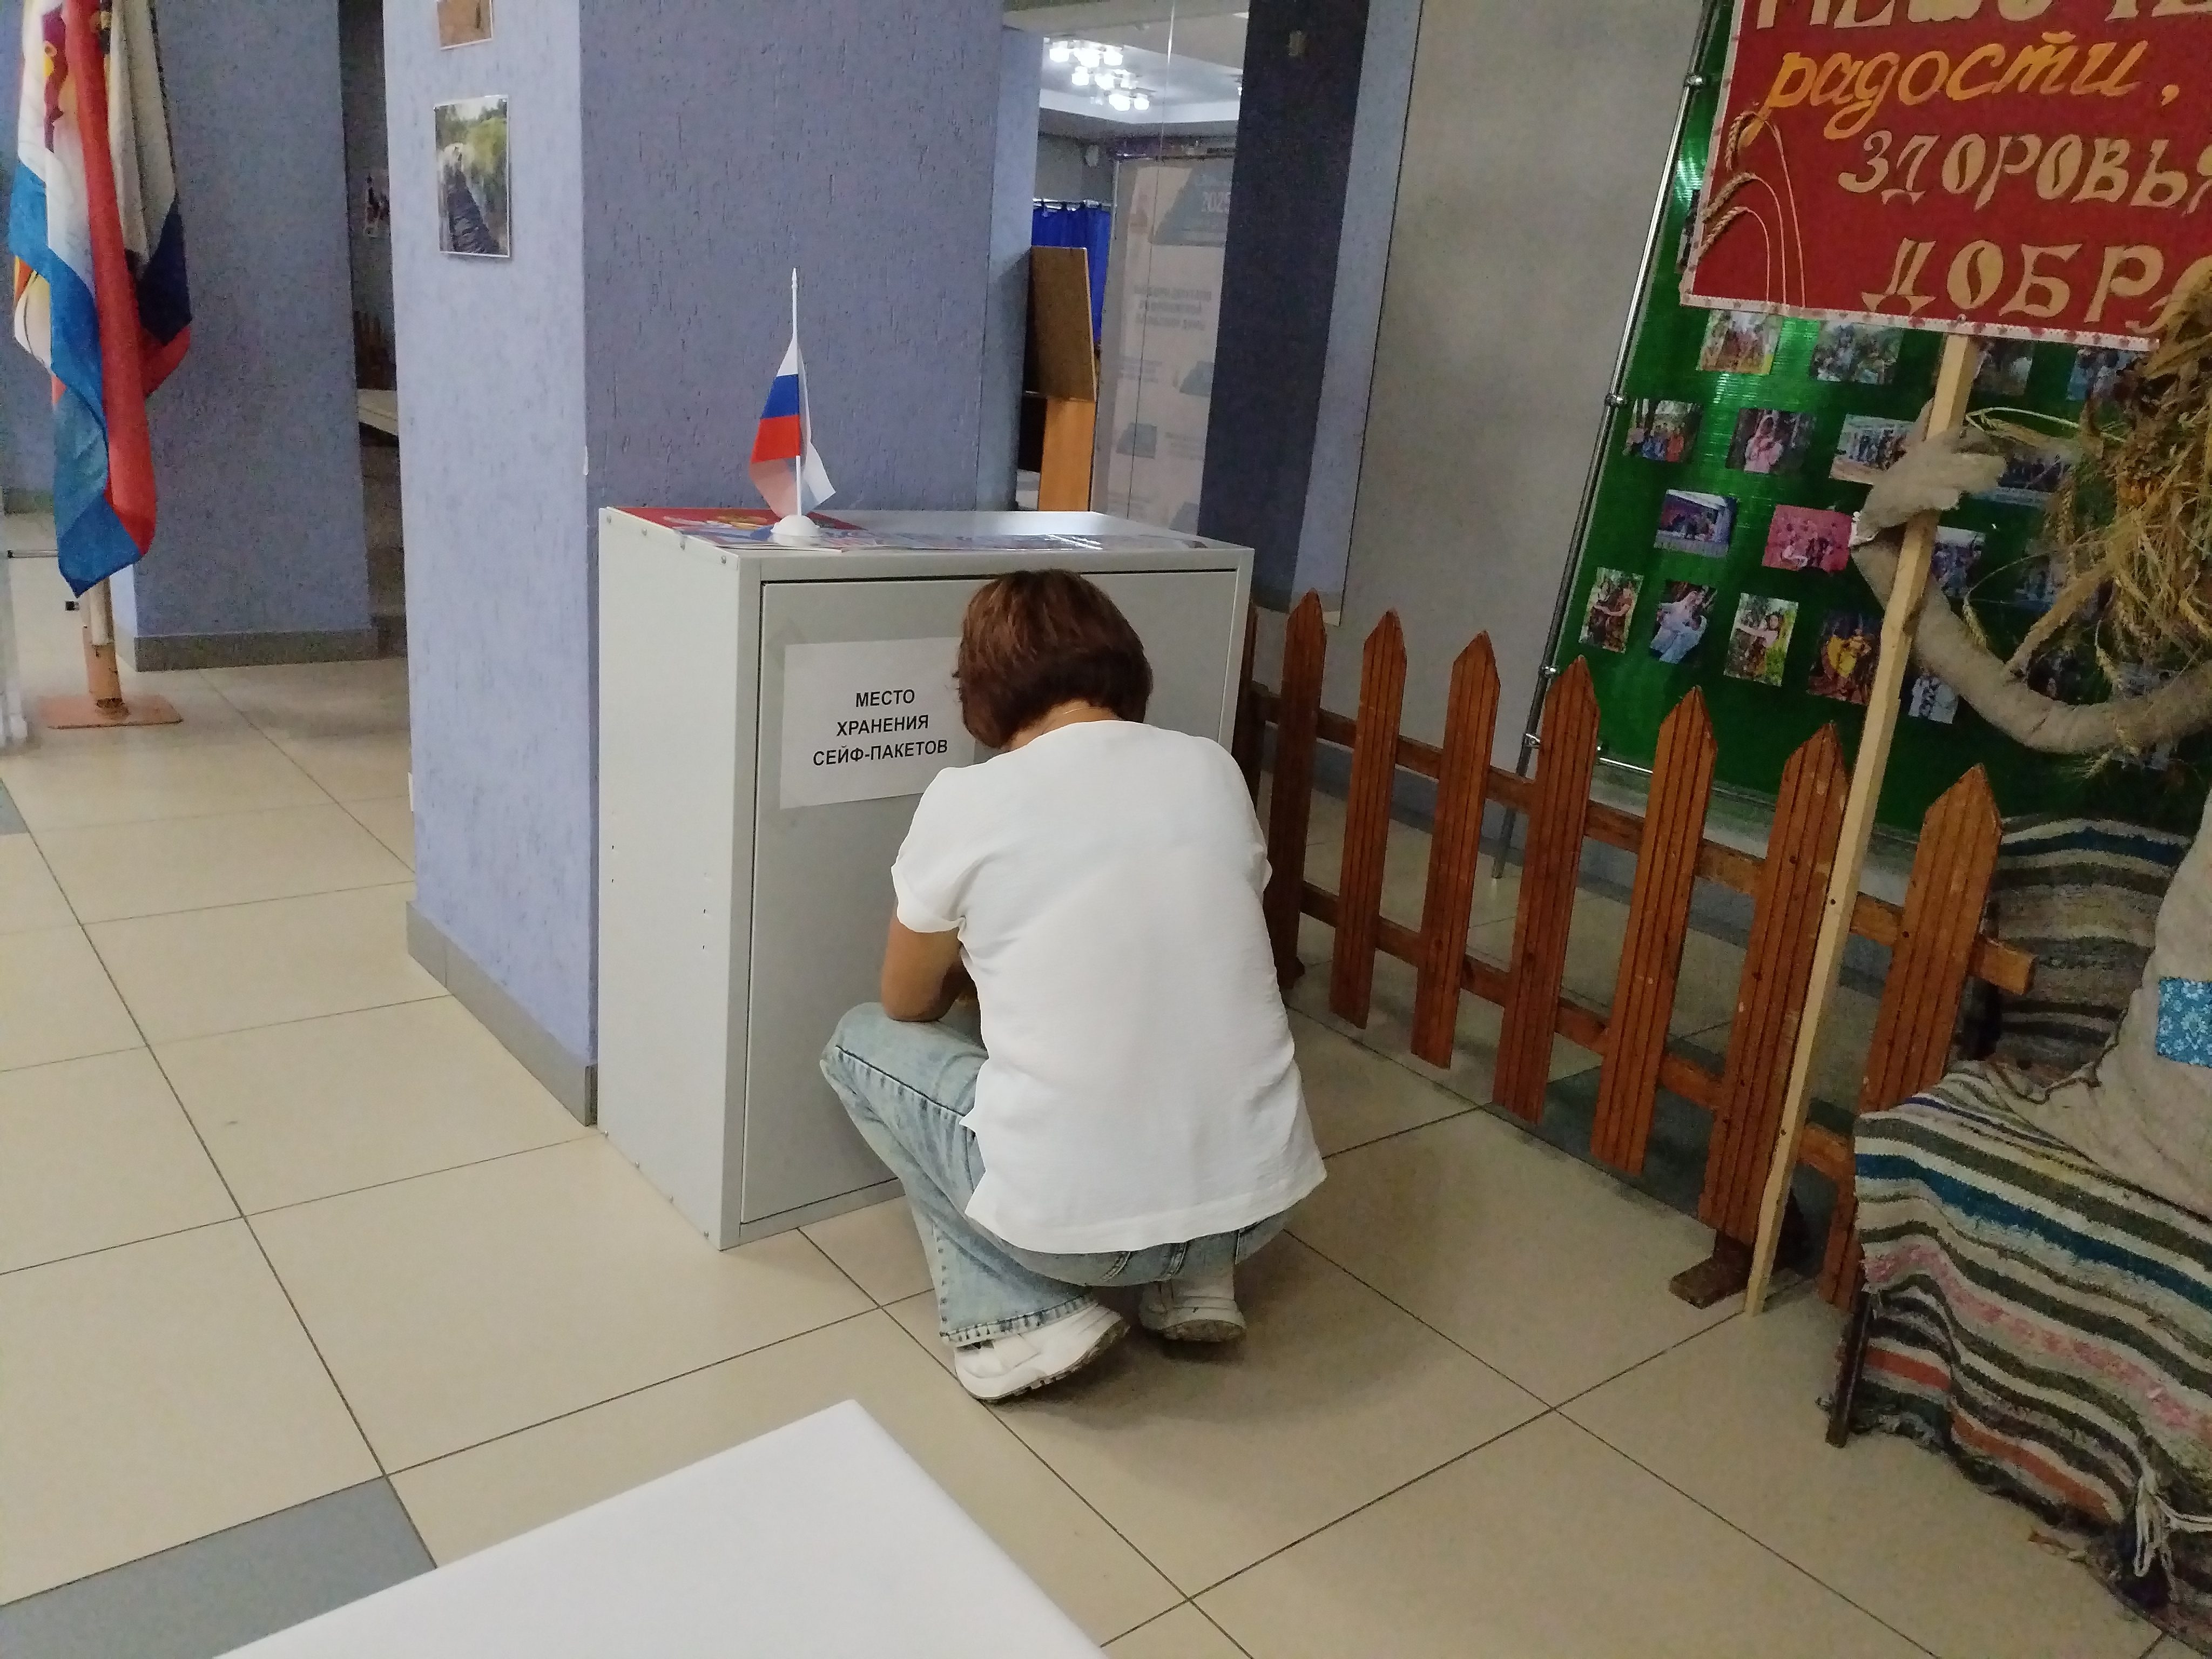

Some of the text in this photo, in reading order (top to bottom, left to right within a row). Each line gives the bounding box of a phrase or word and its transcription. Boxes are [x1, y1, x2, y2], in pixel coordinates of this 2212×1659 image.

[856, 689, 915, 707] МЕСТО
[837, 714, 929, 737] ХРАНЕНИЯ
[813, 739, 948, 766] СЕЙФ-ПАКЕТОВ
